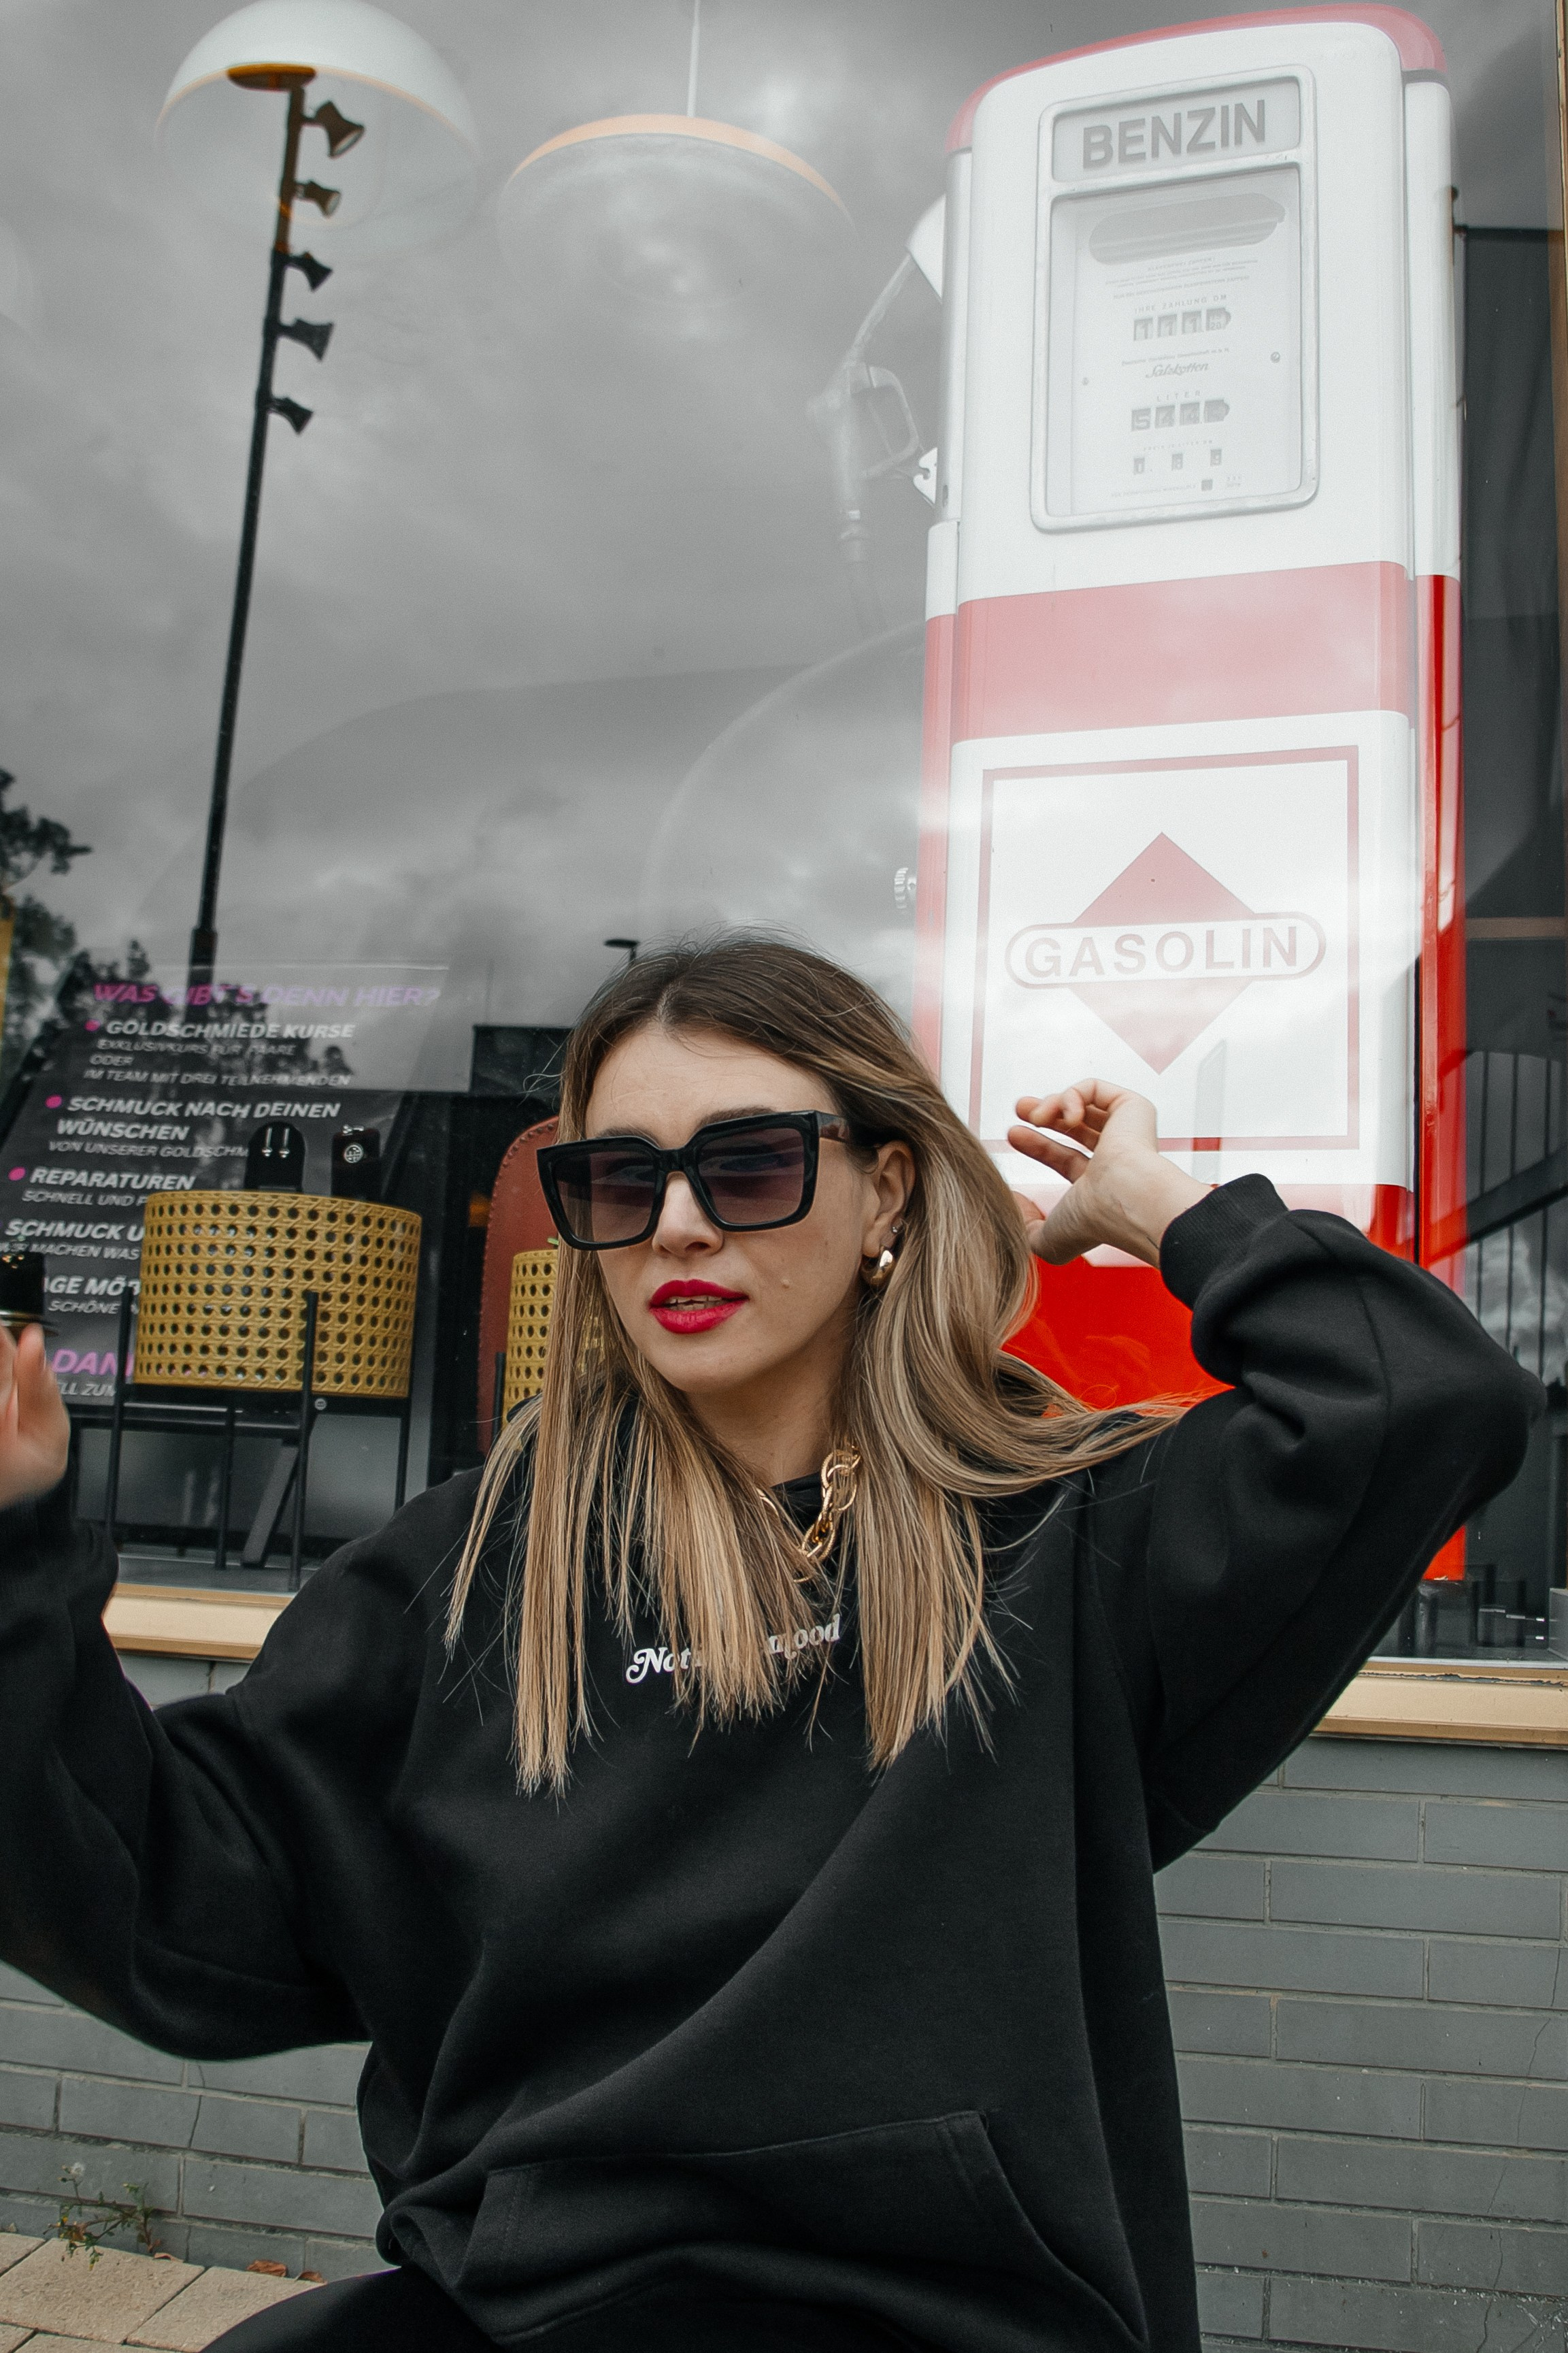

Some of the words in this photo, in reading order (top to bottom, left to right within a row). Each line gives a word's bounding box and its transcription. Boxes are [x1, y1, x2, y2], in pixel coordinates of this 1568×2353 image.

[1082, 99, 1266, 172] BENZIN
[1024, 925, 1298, 978] GASOLIN
[93, 983, 159, 1004] WAS
[261, 983, 348, 1007] DENN
[354, 985, 441, 1008] HIER?
[282, 1023, 356, 1039] KURSE
[89, 1054, 135, 1066] ODER
[106, 1070, 149, 1084] TEAM
[67, 1096, 183, 1117] SCHMUCK
[184, 1101, 252, 1118] NACH
[254, 1101, 340, 1119] DEINEN
[57, 1116, 190, 1141] WÜNSCHEN
[48, 1140, 83, 1152] VON
[84, 1141, 159, 1157] UNSERER
[30, 1166, 196, 1191] REPARATUREN
[22, 1190, 93, 1206] SCHNELL
[97, 1194, 135, 1206] UND
[5, 1218, 125, 1240] SCHMUCK
[30, 1243, 102, 1258] MACHEN
[48, 1299, 121, 1315] SCHÖNE
[626, 1647, 691, 1684] Not
